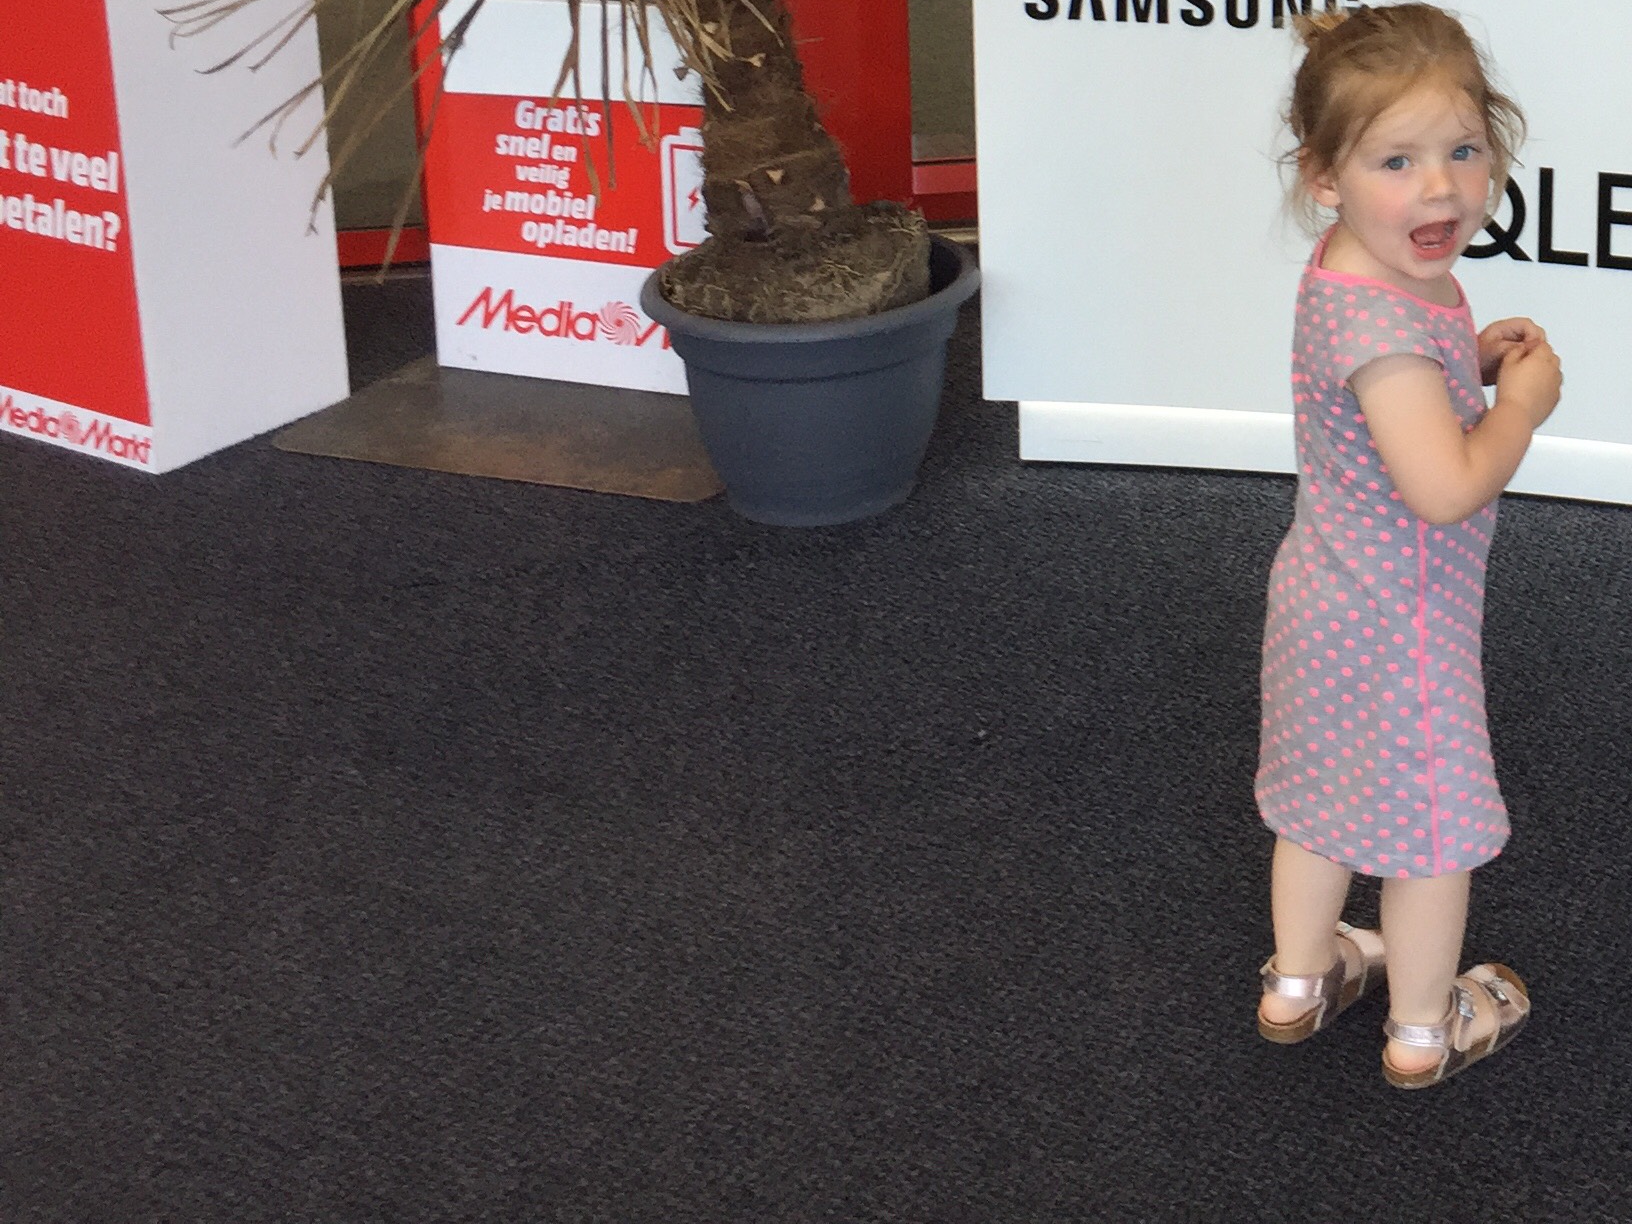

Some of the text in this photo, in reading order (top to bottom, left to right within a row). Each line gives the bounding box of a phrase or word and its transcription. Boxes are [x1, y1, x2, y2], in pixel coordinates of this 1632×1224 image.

[18, 80, 70, 120] toch
[514, 99, 602, 137] Gratis
[14, 132, 48, 178] te
[50, 146, 120, 195] veel
[495, 132, 578, 163] snel en
[515, 163, 571, 189] veilig
[482, 189, 598, 221] je mobiel
[521, 220, 639, 254] opladen!
[456, 286, 600, 342] Media
[79, 418, 153, 465] Markt
